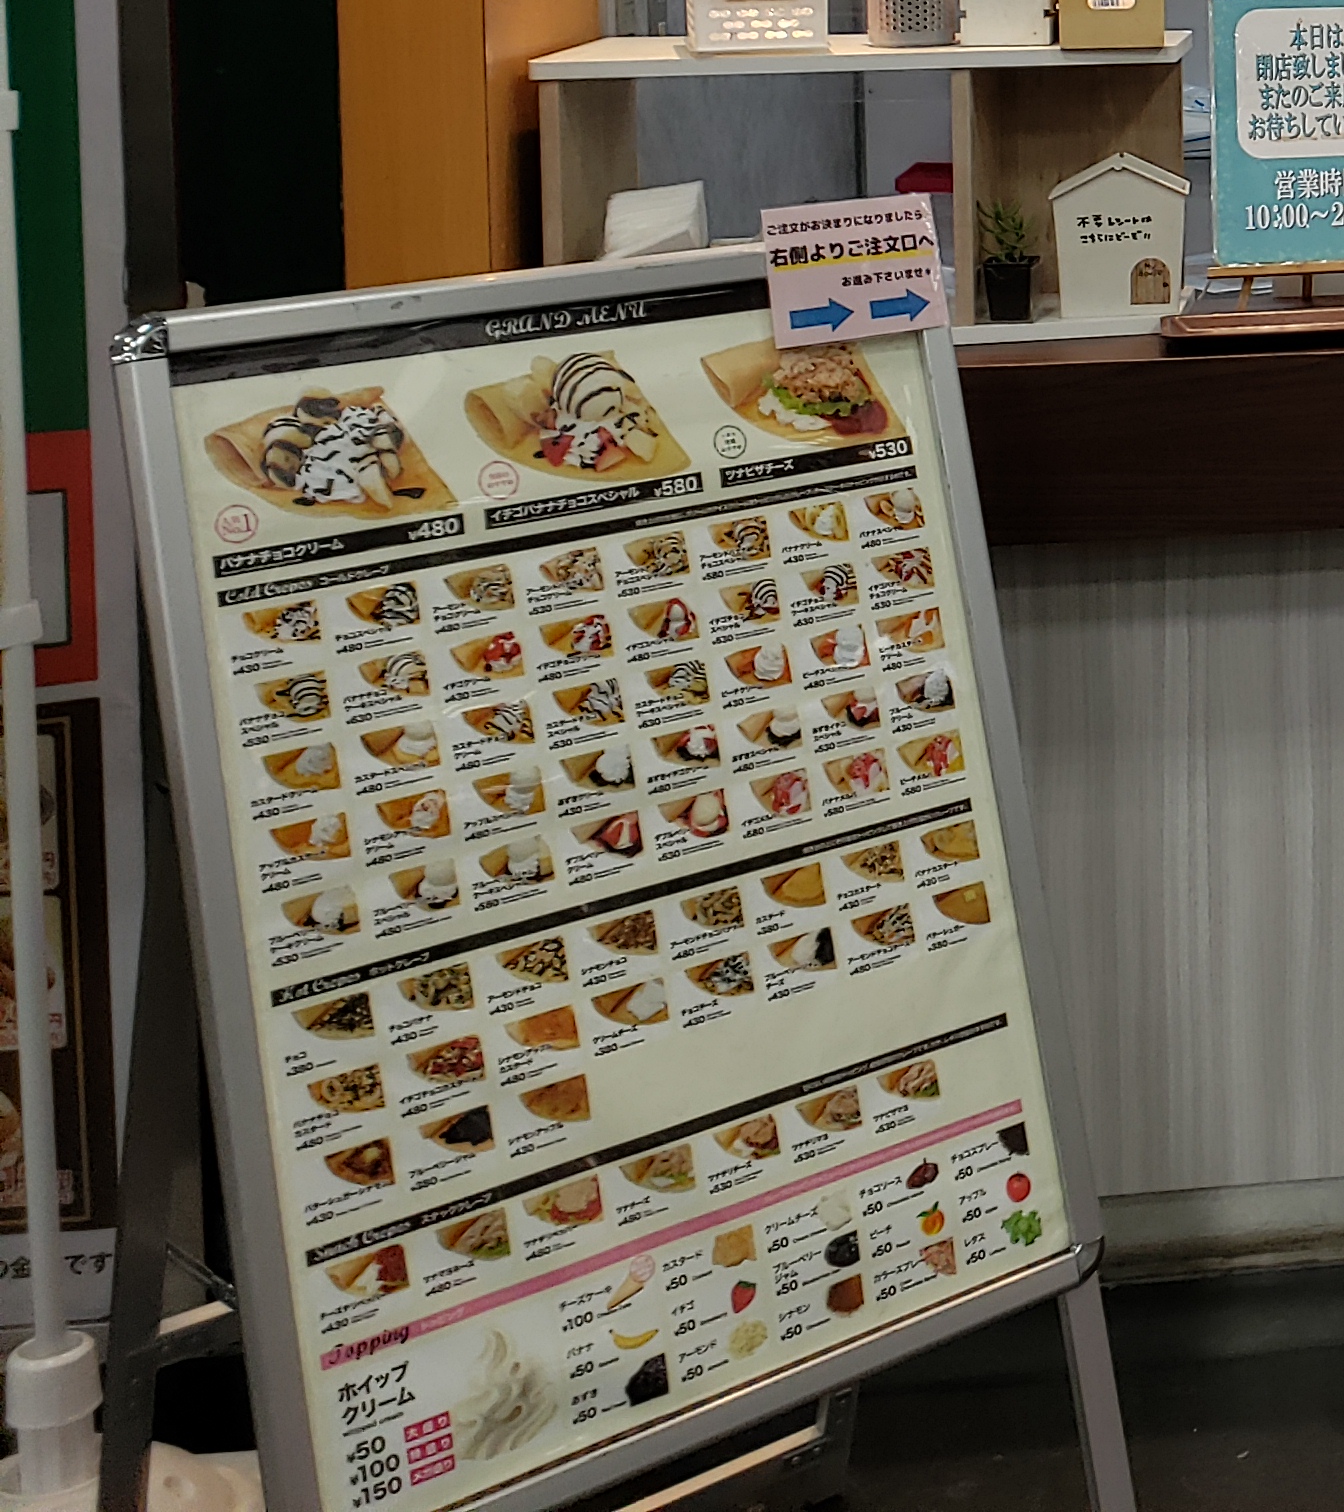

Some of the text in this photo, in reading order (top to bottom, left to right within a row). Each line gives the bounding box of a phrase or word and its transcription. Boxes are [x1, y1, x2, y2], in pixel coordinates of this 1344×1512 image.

[1289, 22, 1344, 50] 本日は
[770, 233, 935, 268] 右側よりご注文口へ
[485, 301, 647, 338] GRAND MENU
[868, 439, 908, 459] ¥530
[725, 458, 794, 481] ツナピザチーズ
[654, 476, 698, 498] ¥580
[490, 486, 640, 522] イチゴバナナチョコスペシャル
[408, 518, 459, 541] ¥480
[220, 538, 344, 570] バナナチョコクリーム
[950, 1140, 1000, 1164] チョコスプレー
[954, 1165, 974, 1182] ¥50
[858, 1175, 903, 1199] チョコソース
[957, 1188, 988, 1206] アップル
[764, 1204, 820, 1236] クリームチーズ
[862, 1200, 884, 1218] ¥50
[961, 1206, 983, 1224] ¥50
[868, 1223, 893, 1241] ピーチ
[963, 1232, 987, 1248] レタス
[767, 1236, 790, 1254] ¥50
[871, 1241, 894, 1259] ¥50
[965, 1248, 987, 1266] ¥50
[775, 1278, 799, 1297] ¥50
[875, 1284, 898, 1302] ¥50
[670, 1299, 696, 1317] イチゴ
[779, 1323, 803, 1342] ¥50
[328, 1326, 411, 1365] Topping
[677, 1338, 718, 1364] アーモンド
[337, 1359, 411, 1403] ホイップ
[340, 1386, 416, 1426] クリーム
[345, 1435, 387, 1464] ¥50
[349, 1453, 401, 1487] ¥100
[352, 1475, 403, 1509] ¥150
